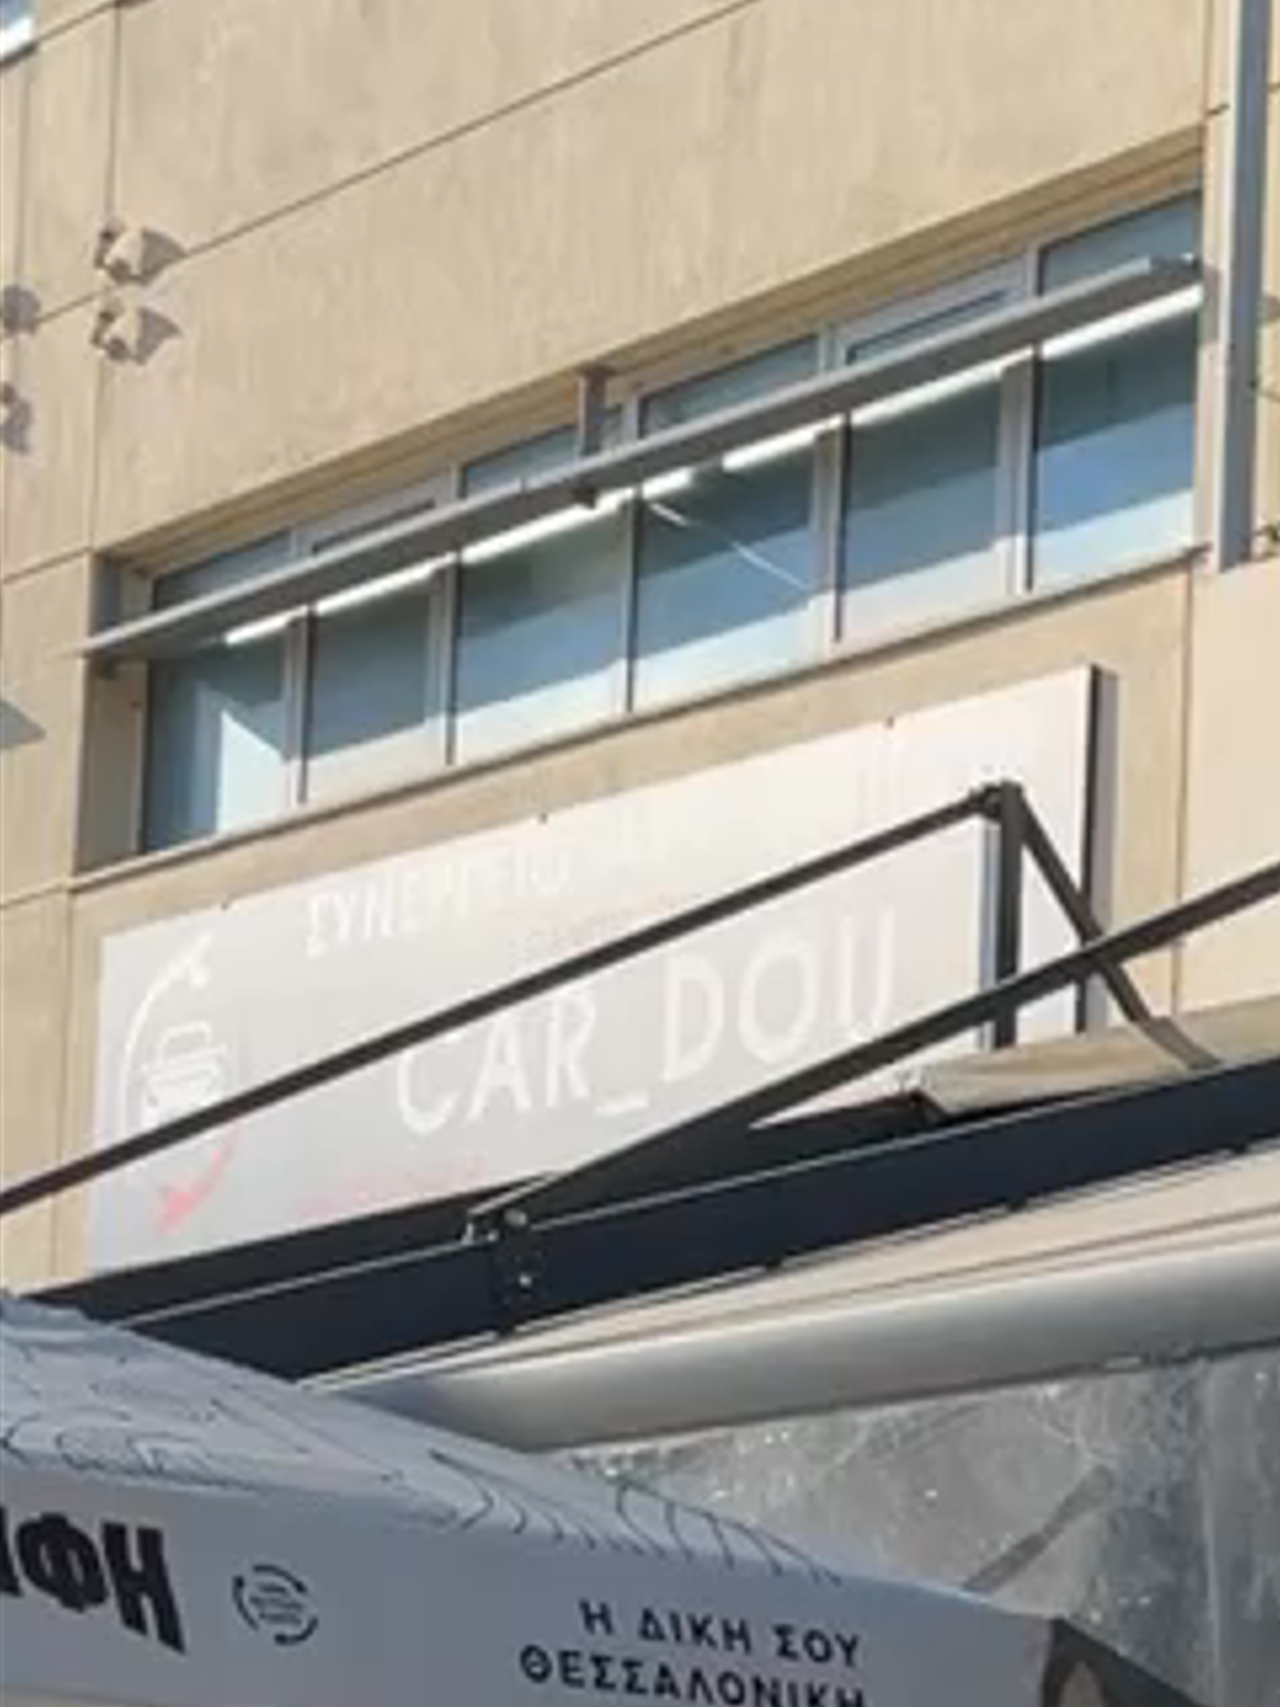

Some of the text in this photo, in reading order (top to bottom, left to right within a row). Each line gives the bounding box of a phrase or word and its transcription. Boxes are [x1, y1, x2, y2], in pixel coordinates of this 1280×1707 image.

[579, 1598, 861, 1670] Η ΔΙΚΗ ΣΟΥ
